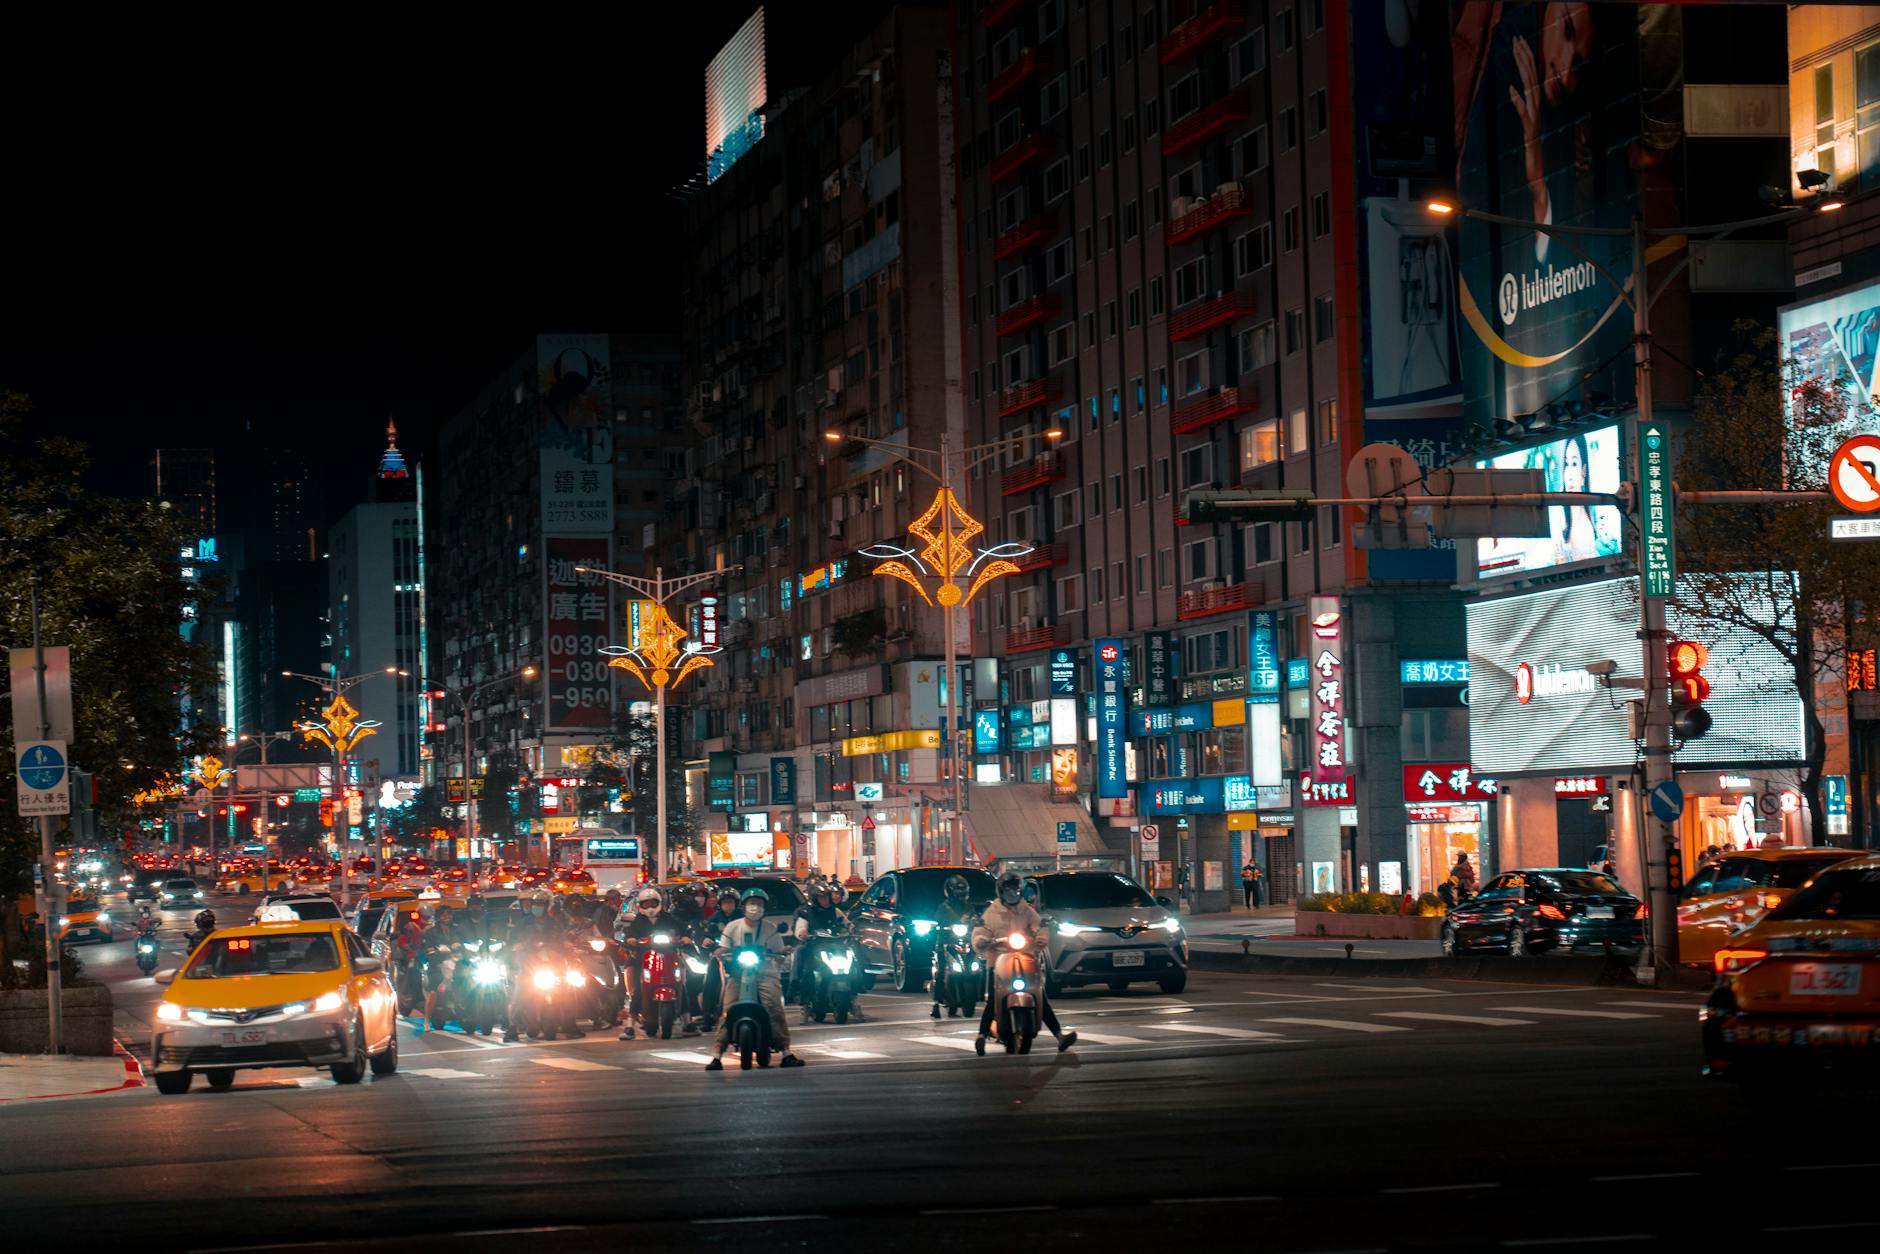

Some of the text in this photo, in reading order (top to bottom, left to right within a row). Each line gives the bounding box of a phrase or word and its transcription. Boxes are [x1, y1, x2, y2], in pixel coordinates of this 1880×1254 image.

[1522, 260, 1596, 310] lululemon
[1648, 452, 1664, 534] 忠孝東路四段
[547, 511, 575, 522] 2773
[550, 592, 607, 621] 廣告
[551, 634, 608, 656] 0930
[551, 660, 608, 682] -030
[1255, 672, 1274, 685] 6F
[552, 687, 609, 708] -950
[1104, 666, 1117, 722] 永豐銀行
[1109, 751, 1117, 781] SinoPac
[1830, 781, 1836, 800] P
